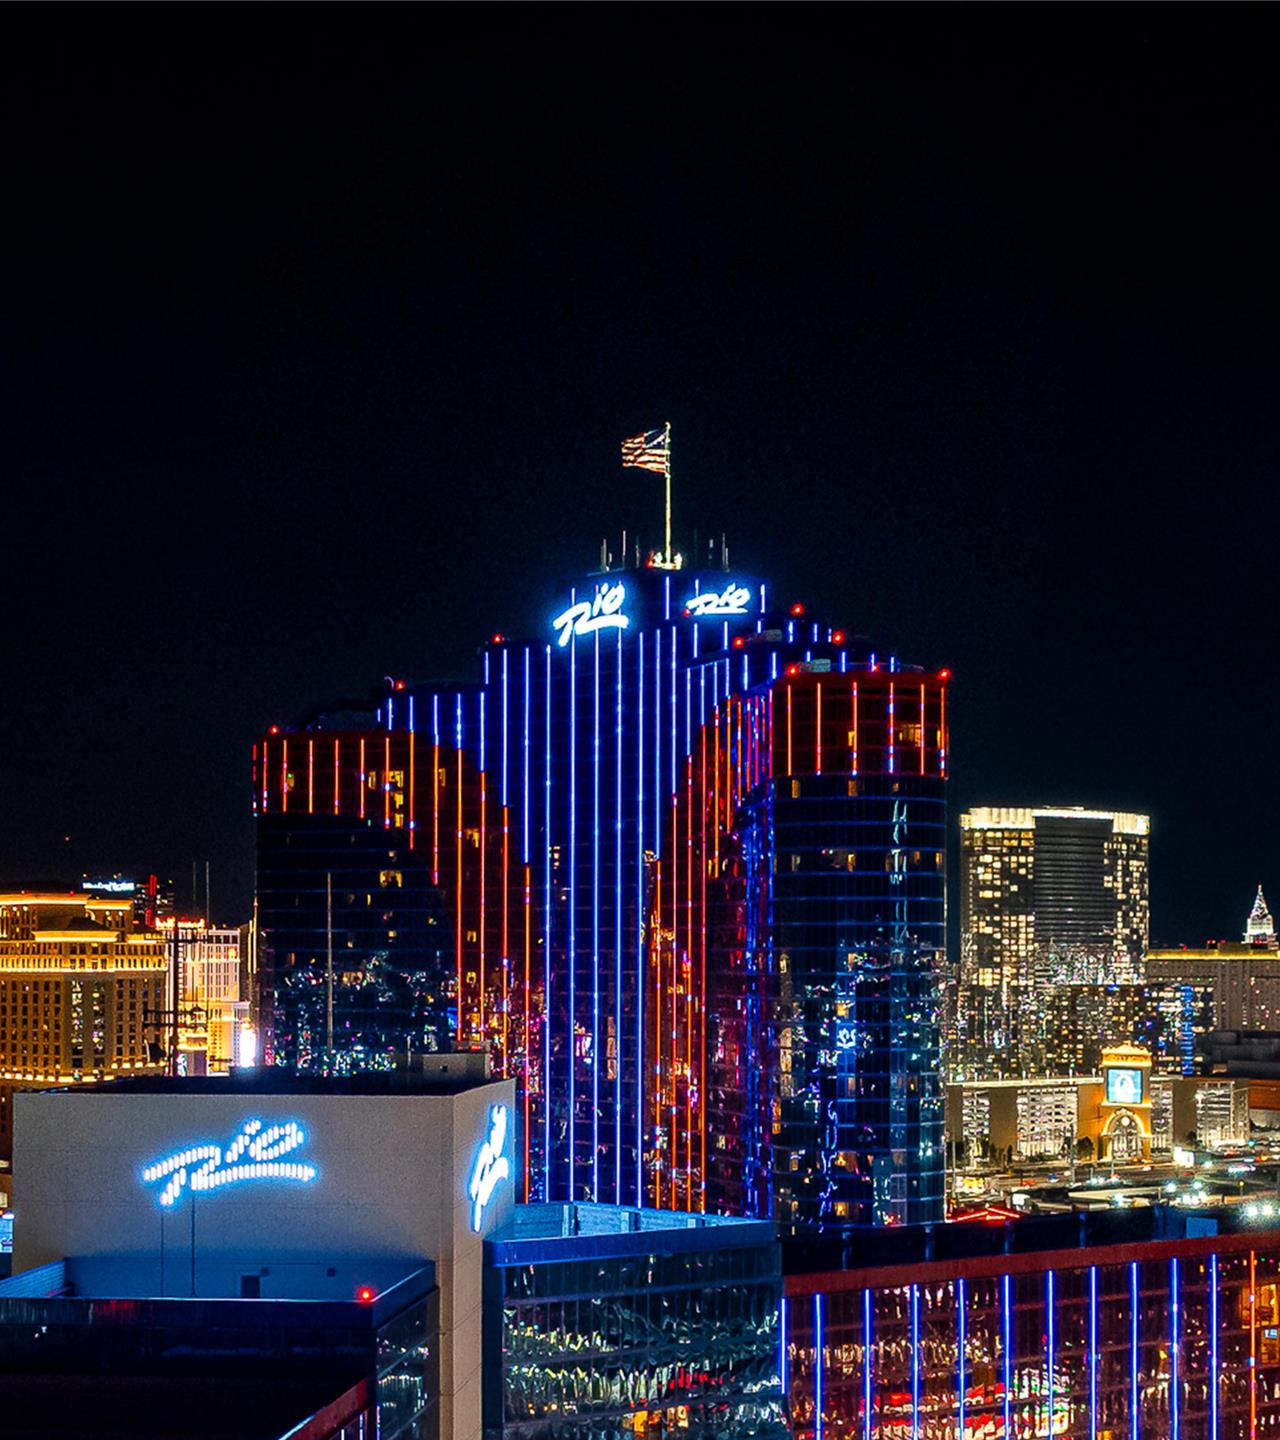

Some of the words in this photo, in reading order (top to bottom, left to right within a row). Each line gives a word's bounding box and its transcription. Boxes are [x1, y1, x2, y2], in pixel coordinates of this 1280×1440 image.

[552, 582, 629, 647] Rio
[686, 582, 751, 616] Rio
[143, 1110, 316, 1206] Rio
